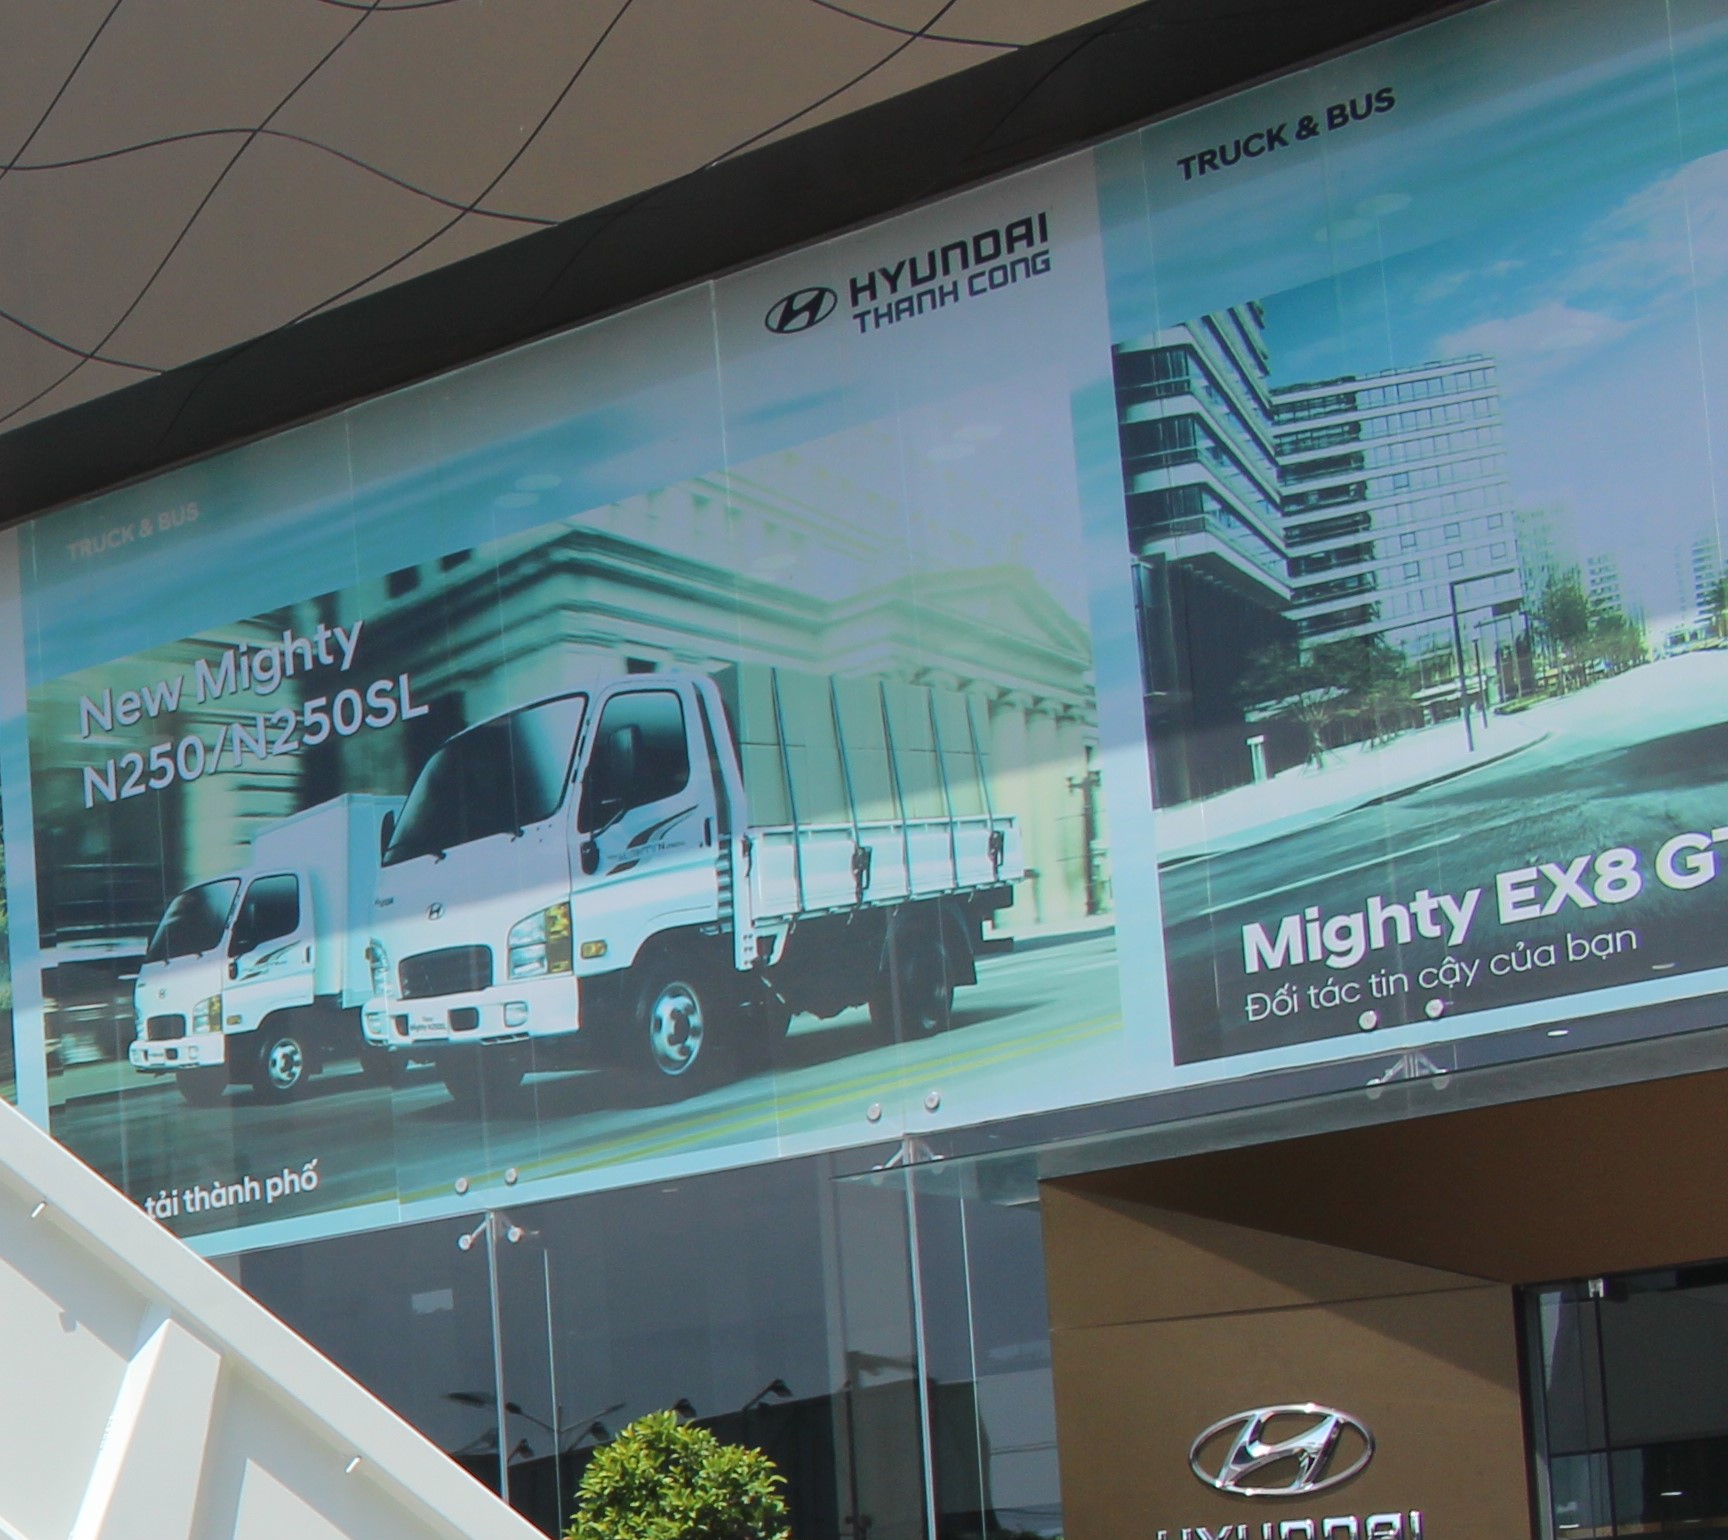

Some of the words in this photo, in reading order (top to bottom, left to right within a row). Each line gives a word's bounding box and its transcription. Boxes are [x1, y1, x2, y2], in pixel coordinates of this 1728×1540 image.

[1177, 122, 1289, 180] TRUCK
[1294, 113, 1320, 140] &
[1325, 86, 1396, 131] BUS
[848, 211, 1049, 307] HYUNDAI
[852, 279, 960, 334] THANH
[968, 250, 1051, 296] CONG
[68, 523, 135, 560] TRUCK
[139, 518, 153, 538] &
[157, 501, 199, 530] BUS
[79, 675, 185, 740] New
[195, 619, 364, 703] Mighty
[81, 672, 430, 809] N250/N250SL
[1243, 887, 1481, 975] Mighty
[1496, 847, 1642, 924] EX8
[1245, 983, 1301, 1022] Đối
[1308, 975, 1362, 1010] tác
[1369, 967, 1410, 1000] tin
[1418, 953, 1480, 992] cậy
[1489, 939, 1556, 976] của
[1567, 928, 1638, 965] bạn
[144, 1189, 179, 1219] tải
[183, 1176, 261, 1213] thành
[266, 1158, 319, 1204] phố
